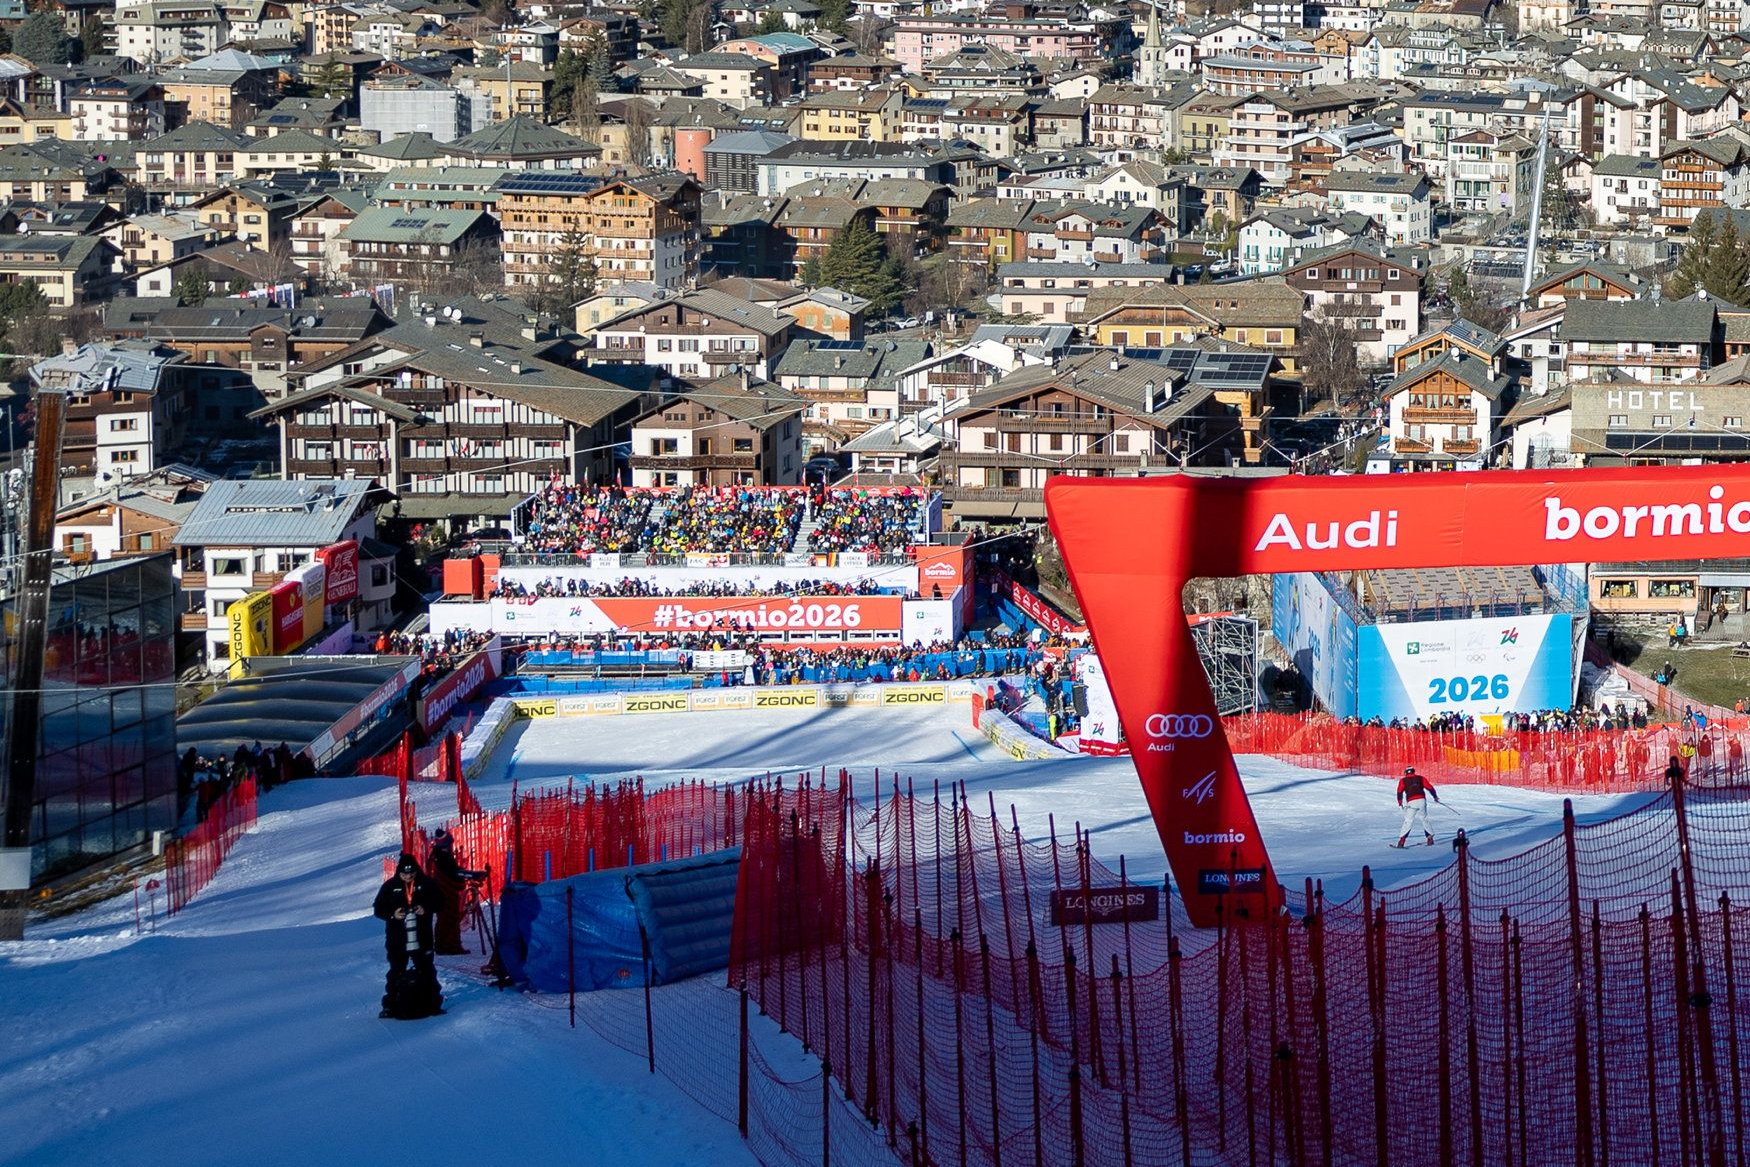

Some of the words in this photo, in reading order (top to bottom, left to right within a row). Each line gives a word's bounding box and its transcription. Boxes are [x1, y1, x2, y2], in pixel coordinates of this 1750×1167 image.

[1608, 390, 1704, 411] HOTEL
[1254, 510, 1398, 551] Audi
[924, 566, 957, 576] bormio
[653, 604, 862, 628] #bormio2026
[232, 612, 243, 660] ZGONC
[427, 659, 486, 727] #bormio2026
[886, 692, 944, 703] ZGONC
[1428, 674, 1510, 704] 2026
[626, 699, 686, 711] ZGONC
[757, 696, 815, 706] ZGONC
[1147, 742, 1175, 752] Audi
[1183, 828, 1245, 844] bormio
